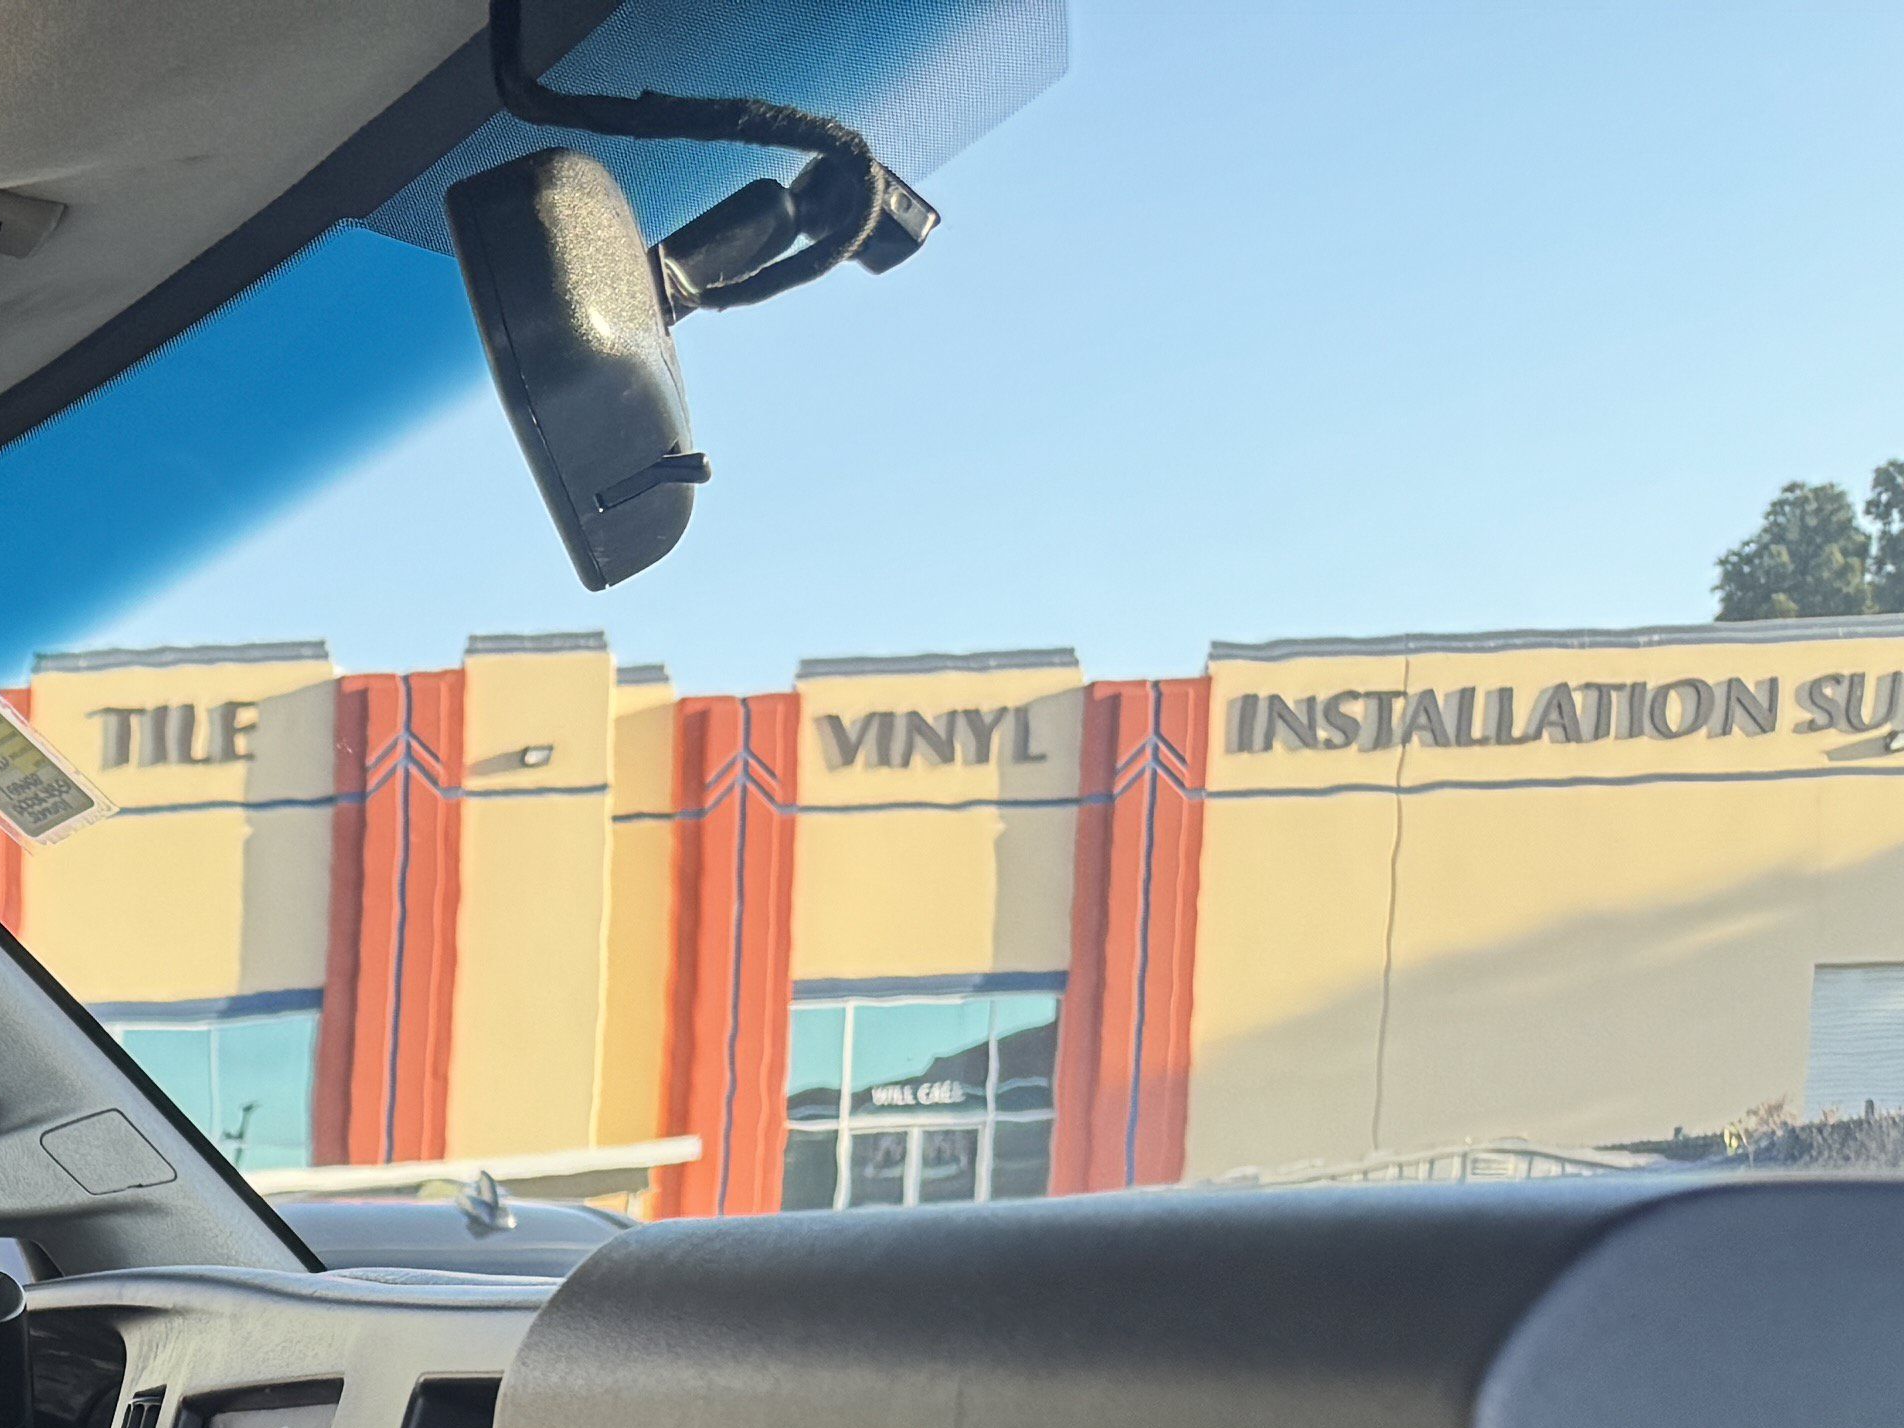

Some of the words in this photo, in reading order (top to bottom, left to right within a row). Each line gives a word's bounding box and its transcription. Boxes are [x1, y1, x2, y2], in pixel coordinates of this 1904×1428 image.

[89, 700, 257, 770] TILE
[820, 706, 1048, 770] VINYL
[1230, 676, 1781, 753] INSTALLATION
[871, 1083, 916, 1106] WILL
[917, 1080, 966, 1105] CALL
